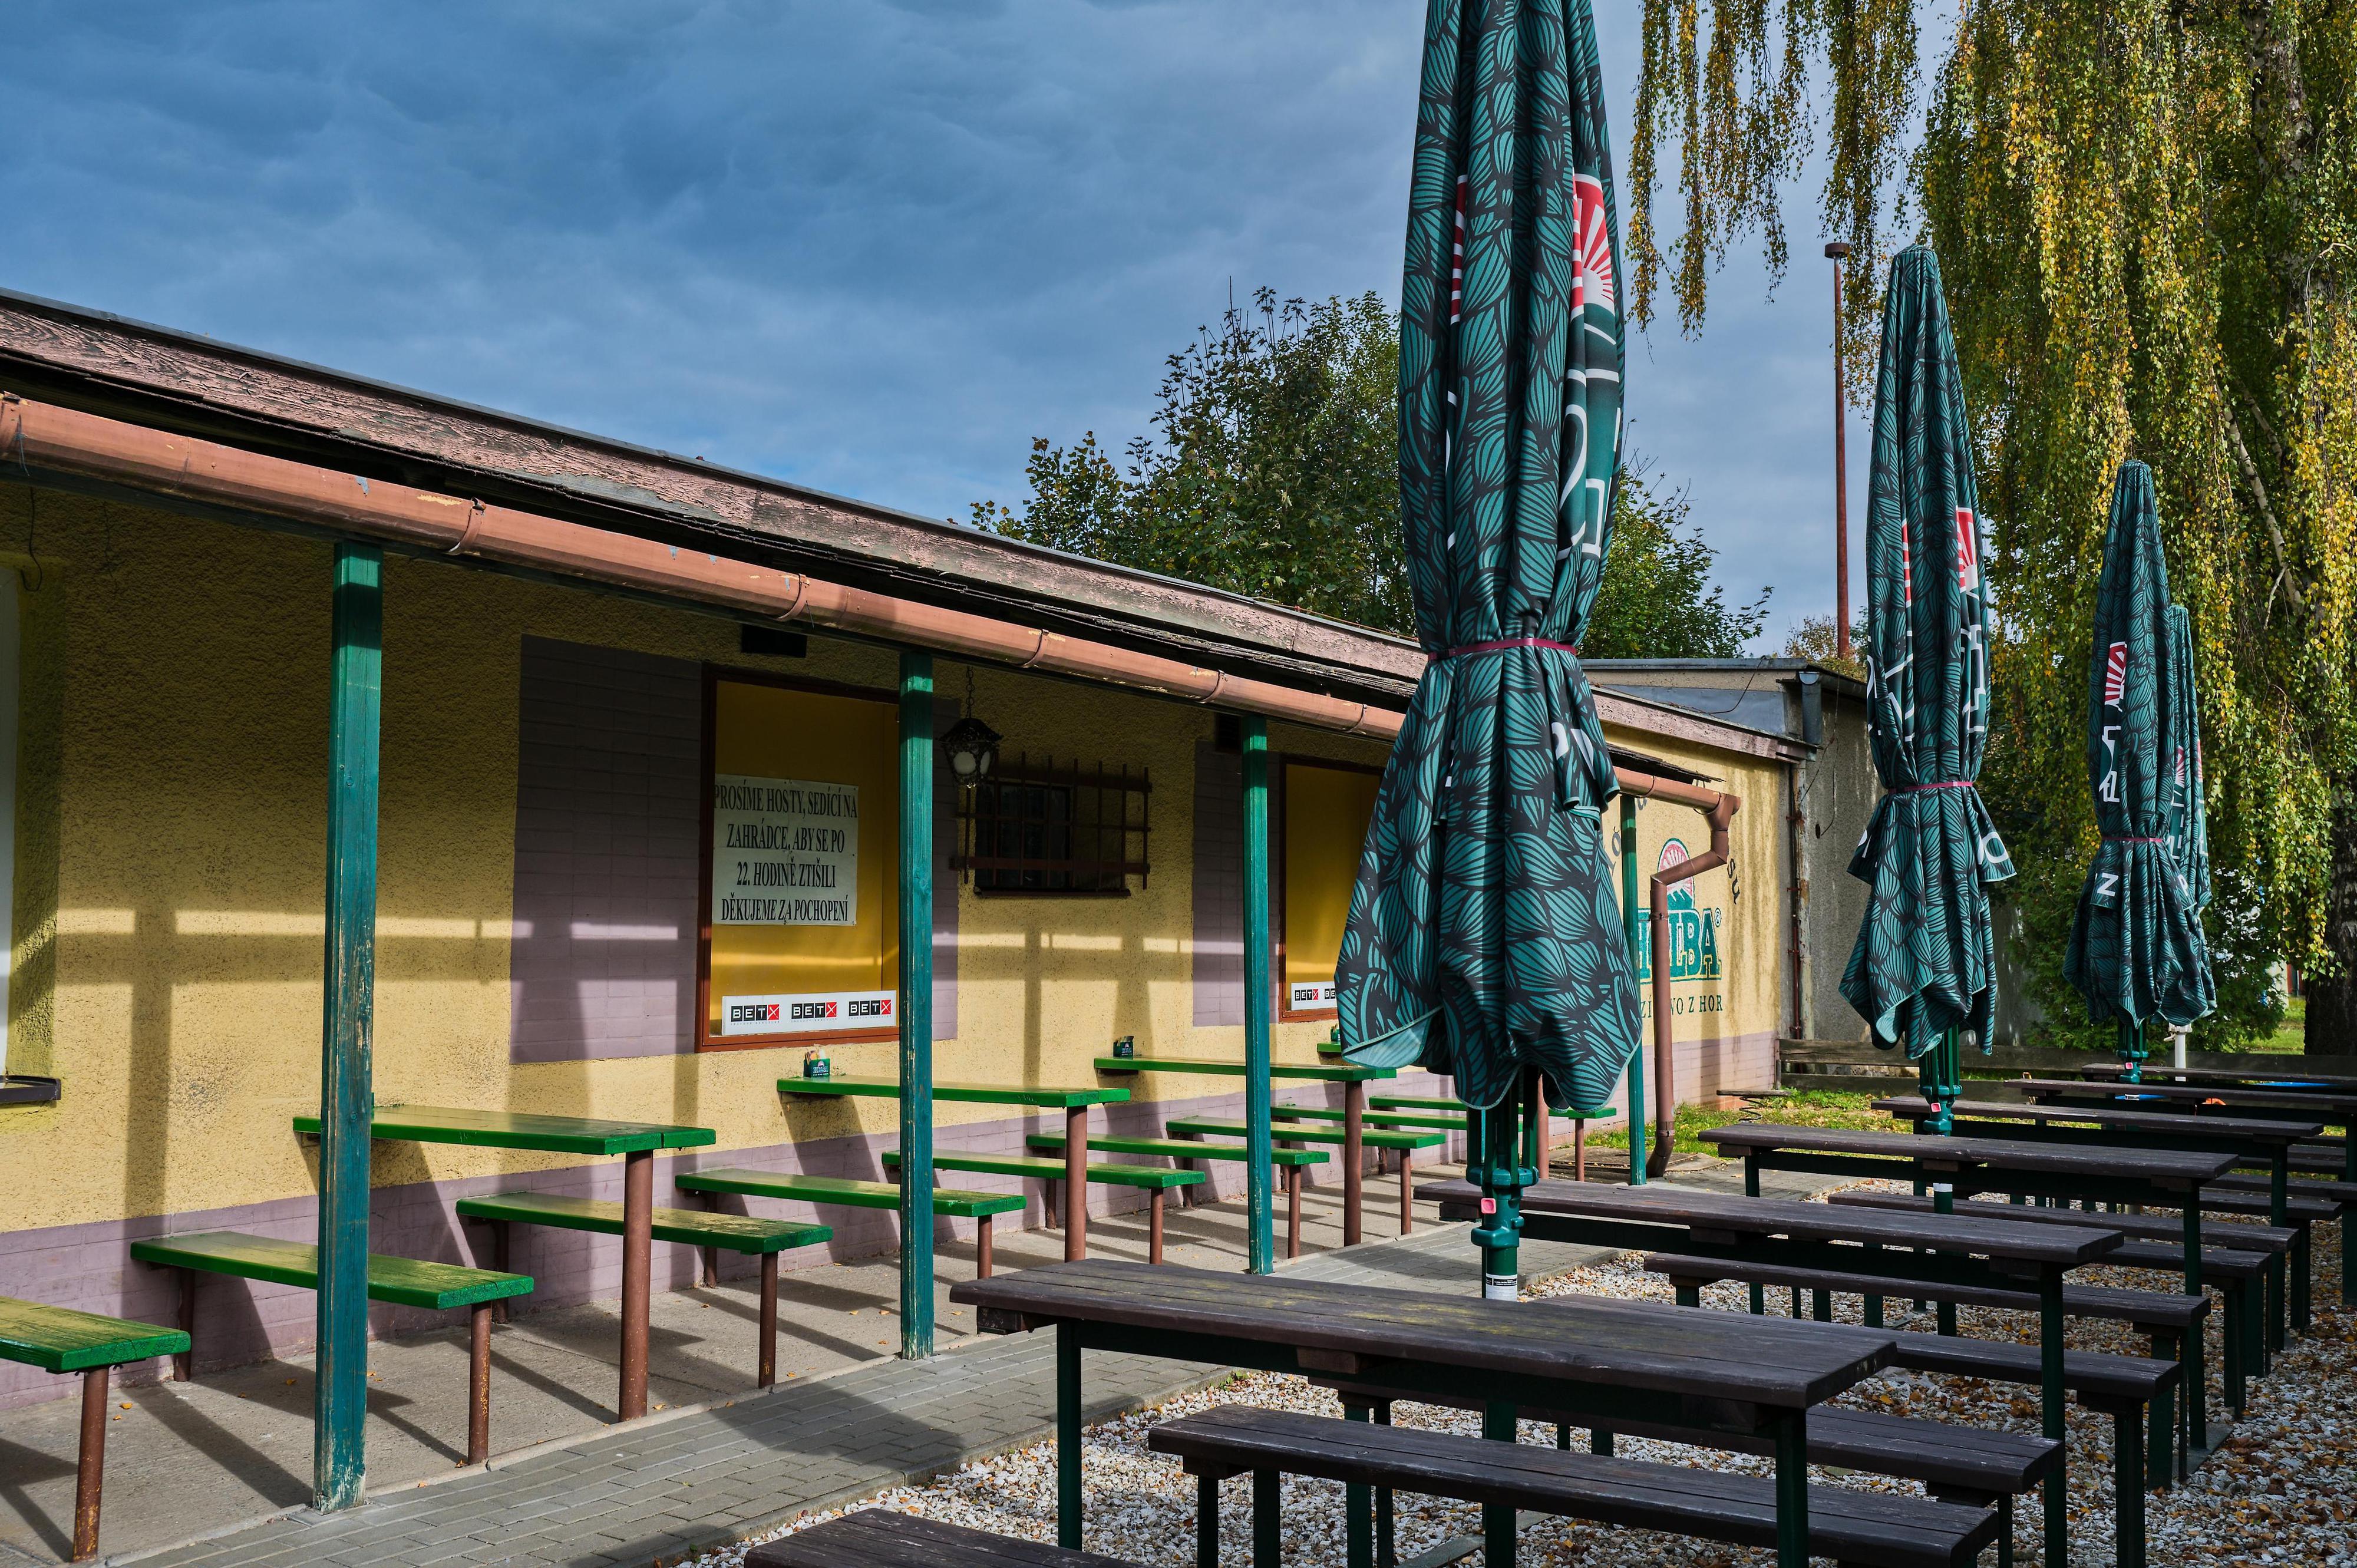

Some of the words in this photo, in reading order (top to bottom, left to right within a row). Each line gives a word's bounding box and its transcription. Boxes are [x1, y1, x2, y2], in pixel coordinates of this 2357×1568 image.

[714, 779, 764, 811] PROSÍME
[766, 788, 806, 819] HOSTY,
[808, 786, 842, 817] SEDÍCÍ
[843, 794, 857, 818] NA
[792, 827, 815, 851] ABY
[816, 828, 828, 852] SE
[831, 829, 845, 853] PO
[737, 861, 750, 886] 22.
[753, 856, 797, 886] HODINĚ
[799, 857, 836, 888] ZTIŠILI
[721, 892, 777, 921] DĚKUJEME
[778, 899, 792, 920] ZA
[794, 894, 849, 921] POCHOPENÍ
[1638, 908, 1722, 984] HLBA
[1295, 989, 1318, 1001] BETX
[1324, 988, 1336, 999] BE
[1688, 996, 1694, 1013] Z
[1699, 995, 1723, 1012] HOR
[731, 1004, 780, 1022] BETX
[791, 1002, 837, 1019] BETX
[849, 999, 891, 1016] BETX
